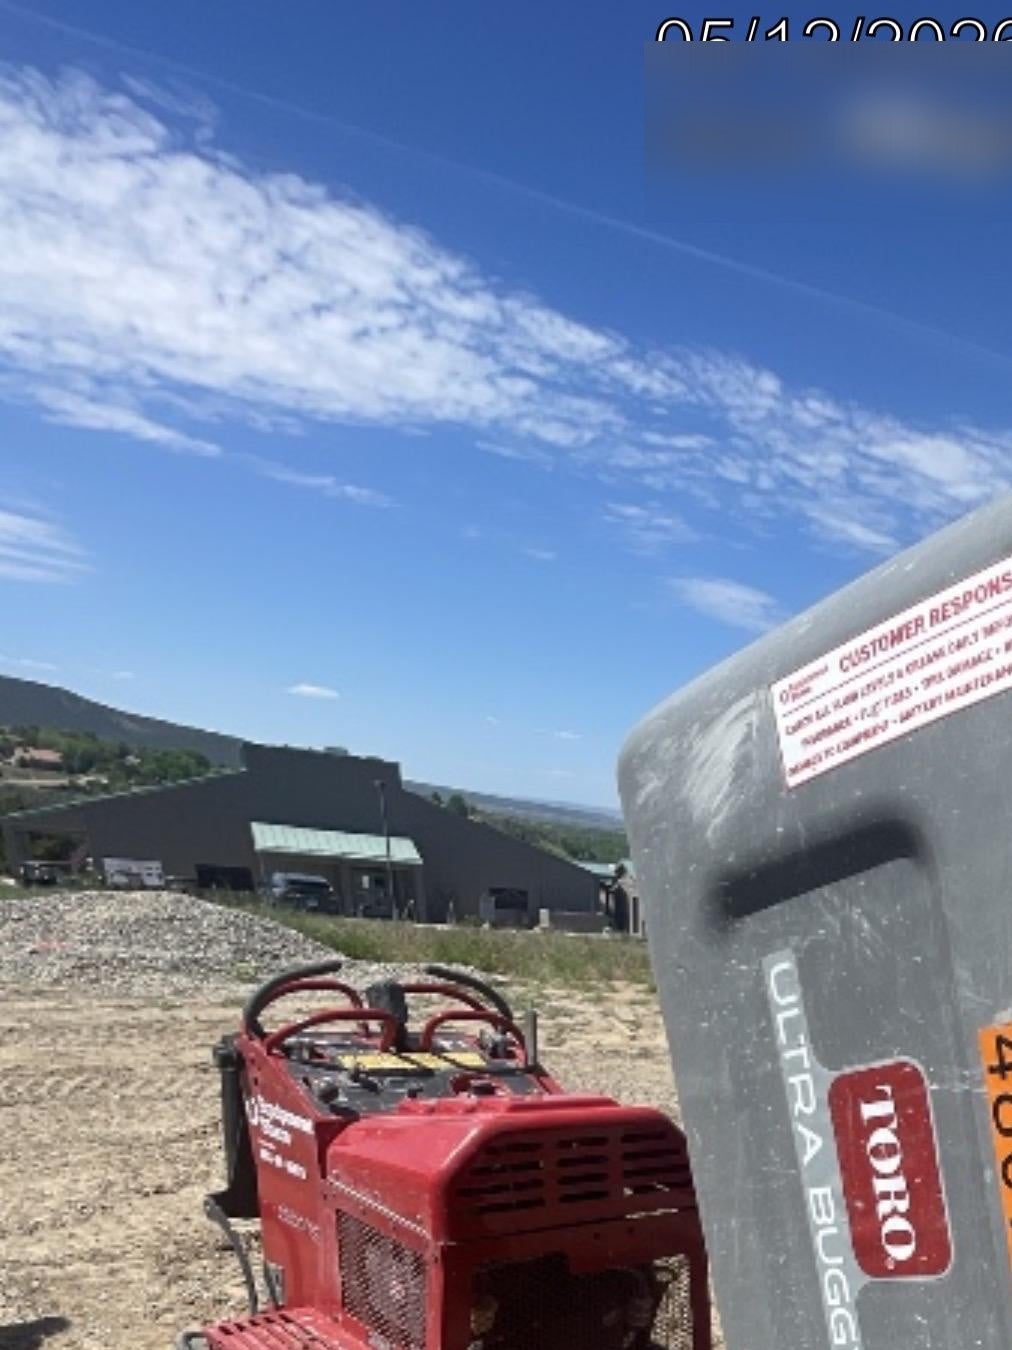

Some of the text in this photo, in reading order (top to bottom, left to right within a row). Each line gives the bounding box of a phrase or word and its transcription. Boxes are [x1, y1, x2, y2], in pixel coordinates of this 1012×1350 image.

[839, 615, 925, 673] CUSTOMER
[769, 962, 823, 1165] ULTRA
[859, 1085, 916, 1262] TORO
